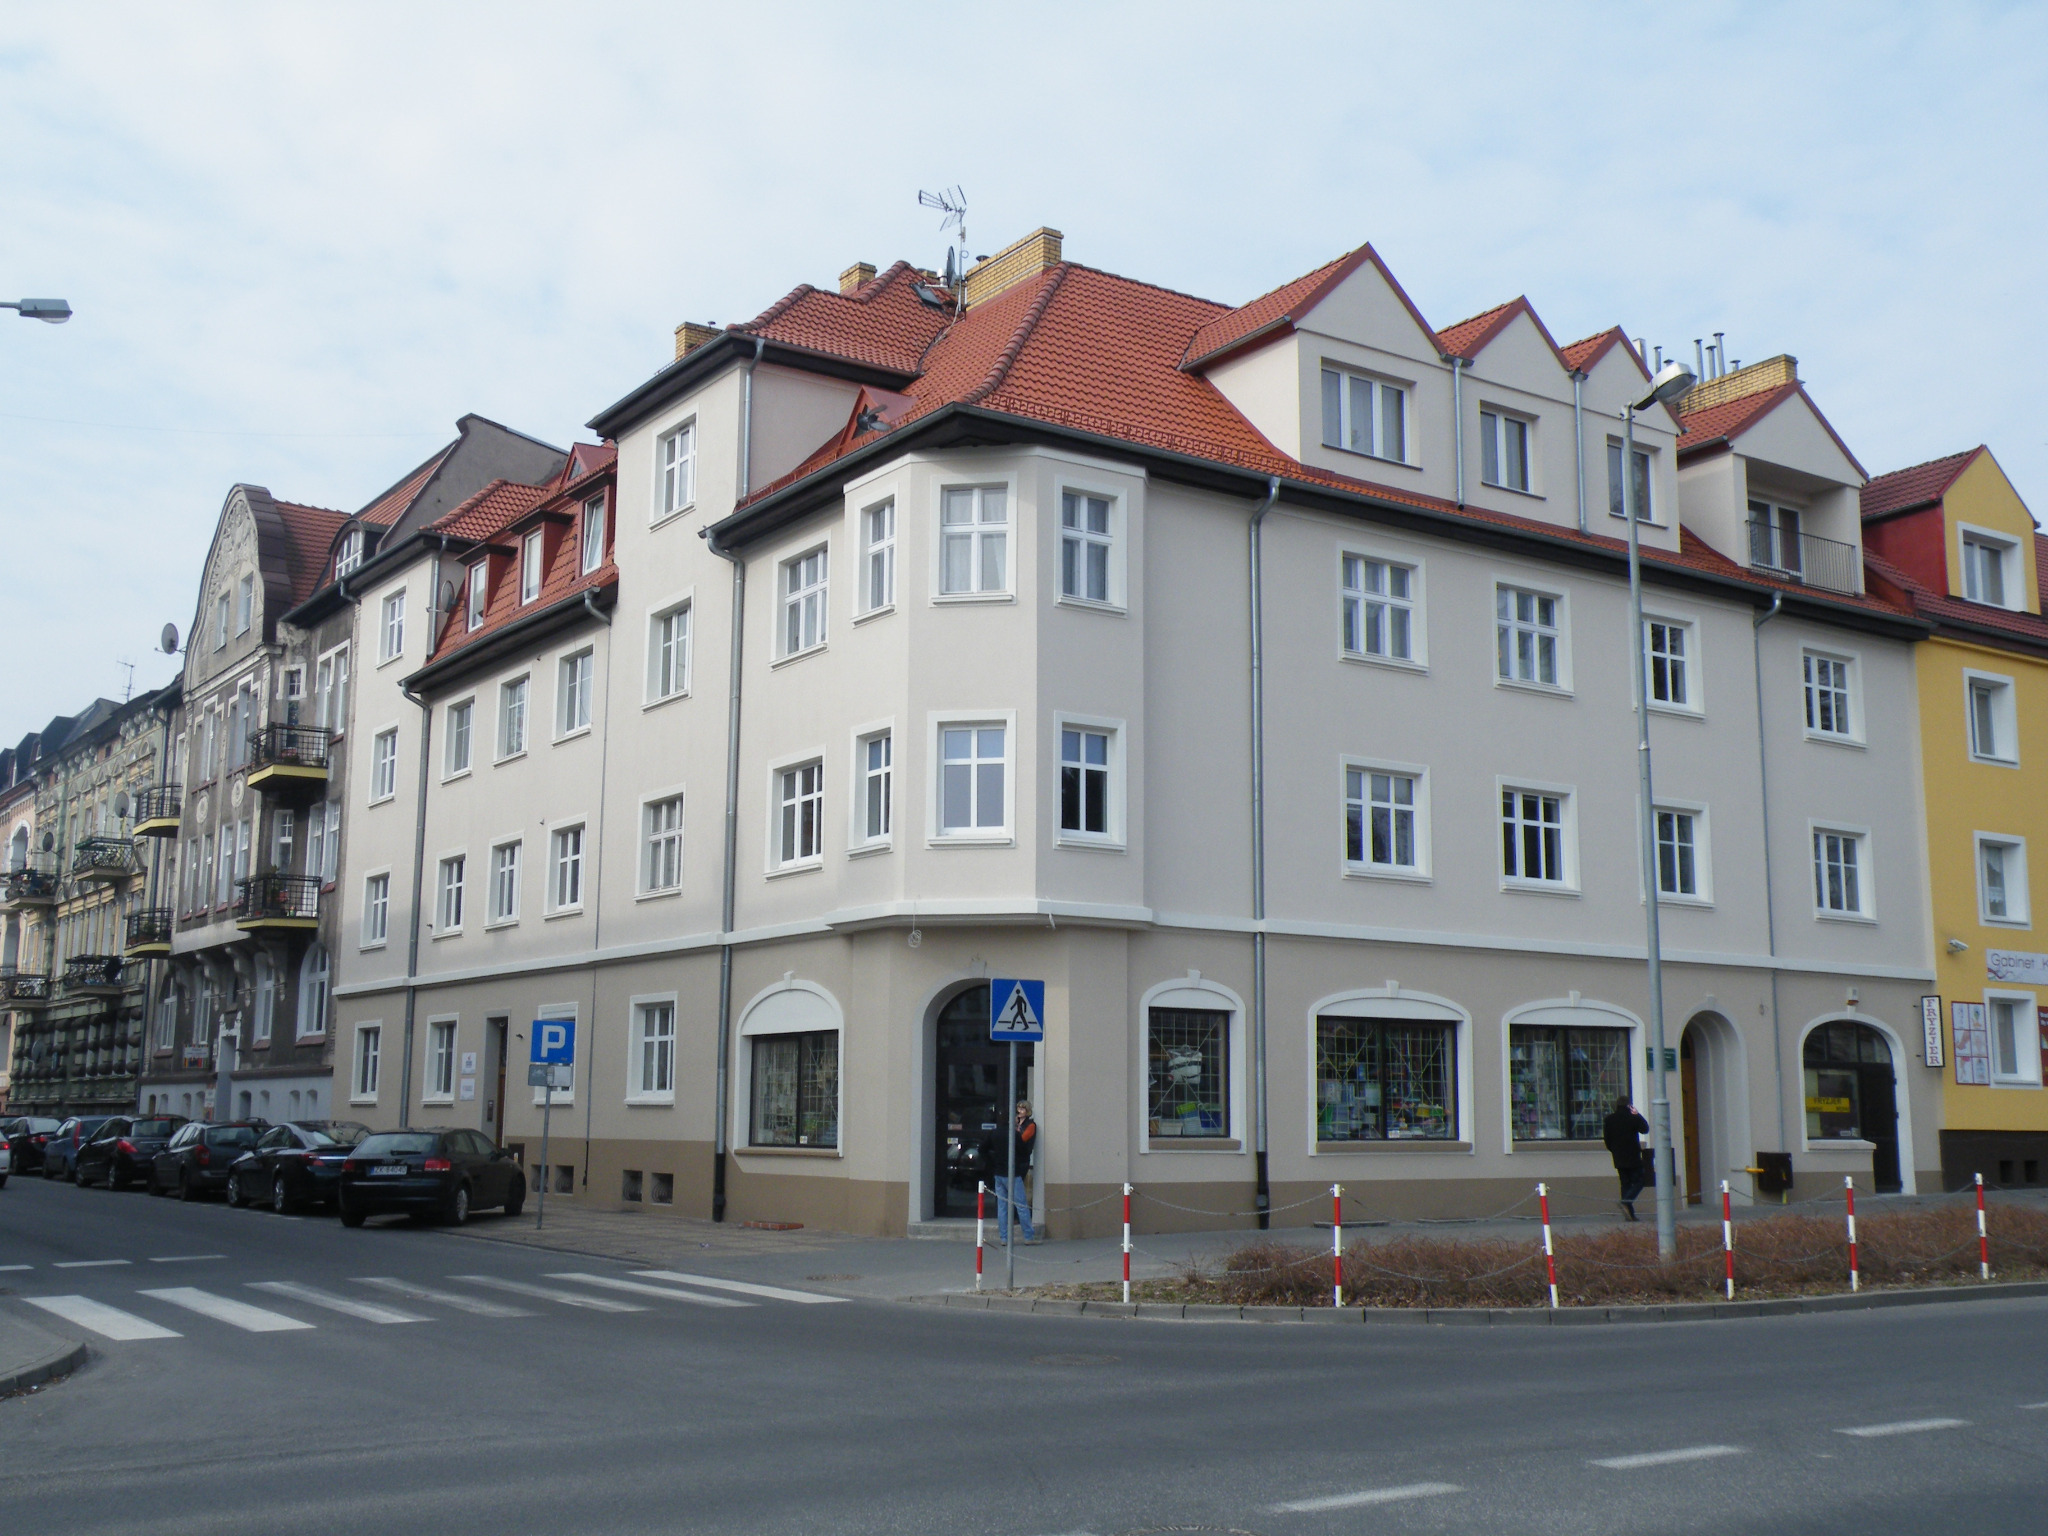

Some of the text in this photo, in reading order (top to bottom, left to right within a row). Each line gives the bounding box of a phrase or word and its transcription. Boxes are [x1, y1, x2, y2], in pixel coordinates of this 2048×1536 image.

[1991, 953, 2035, 969] Gabinet
[541, 1025, 566, 1058] P
[1926, 998, 1940, 1065] FRYZJER
